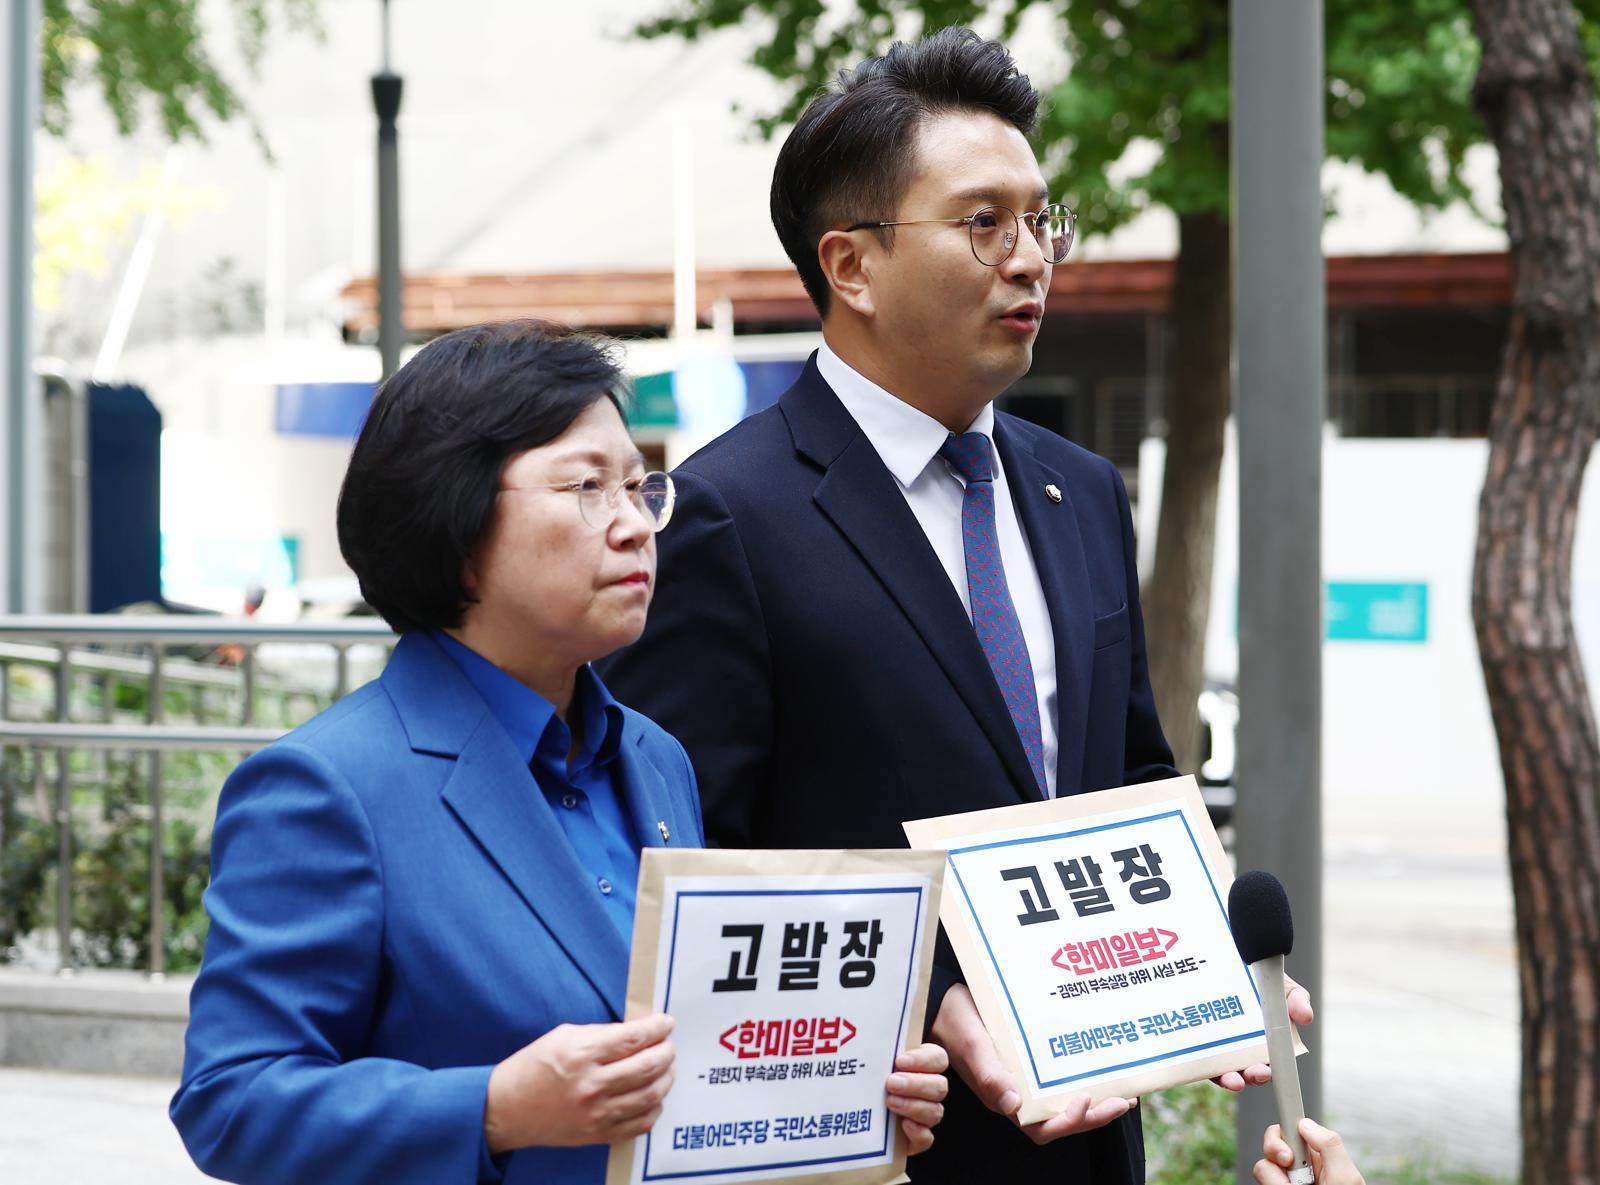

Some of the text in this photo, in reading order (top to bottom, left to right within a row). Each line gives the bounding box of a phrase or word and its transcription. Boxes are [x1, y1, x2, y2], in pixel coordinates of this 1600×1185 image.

[1000, 844, 1172, 926] 고발장
[712, 919, 883, 992] 고발장
[1050, 928, 1179, 976] <한미일보>
[1088, 973, 1128, 992] 부속실장
[1129, 968, 1152, 985] 허위
[1153, 962, 1174, 980] 사실
[719, 1017, 856, 1059] <한미일보>
[1048, 995, 1245, 1059] 더불어민주당 국민소통위원회
[745, 1064, 789, 1081] 부속실장
[792, 1061, 813, 1078] 허위
[815, 1060, 836, 1077] 사실
[673, 1109, 872, 1150] 더불어민주당 국민소통위원회
